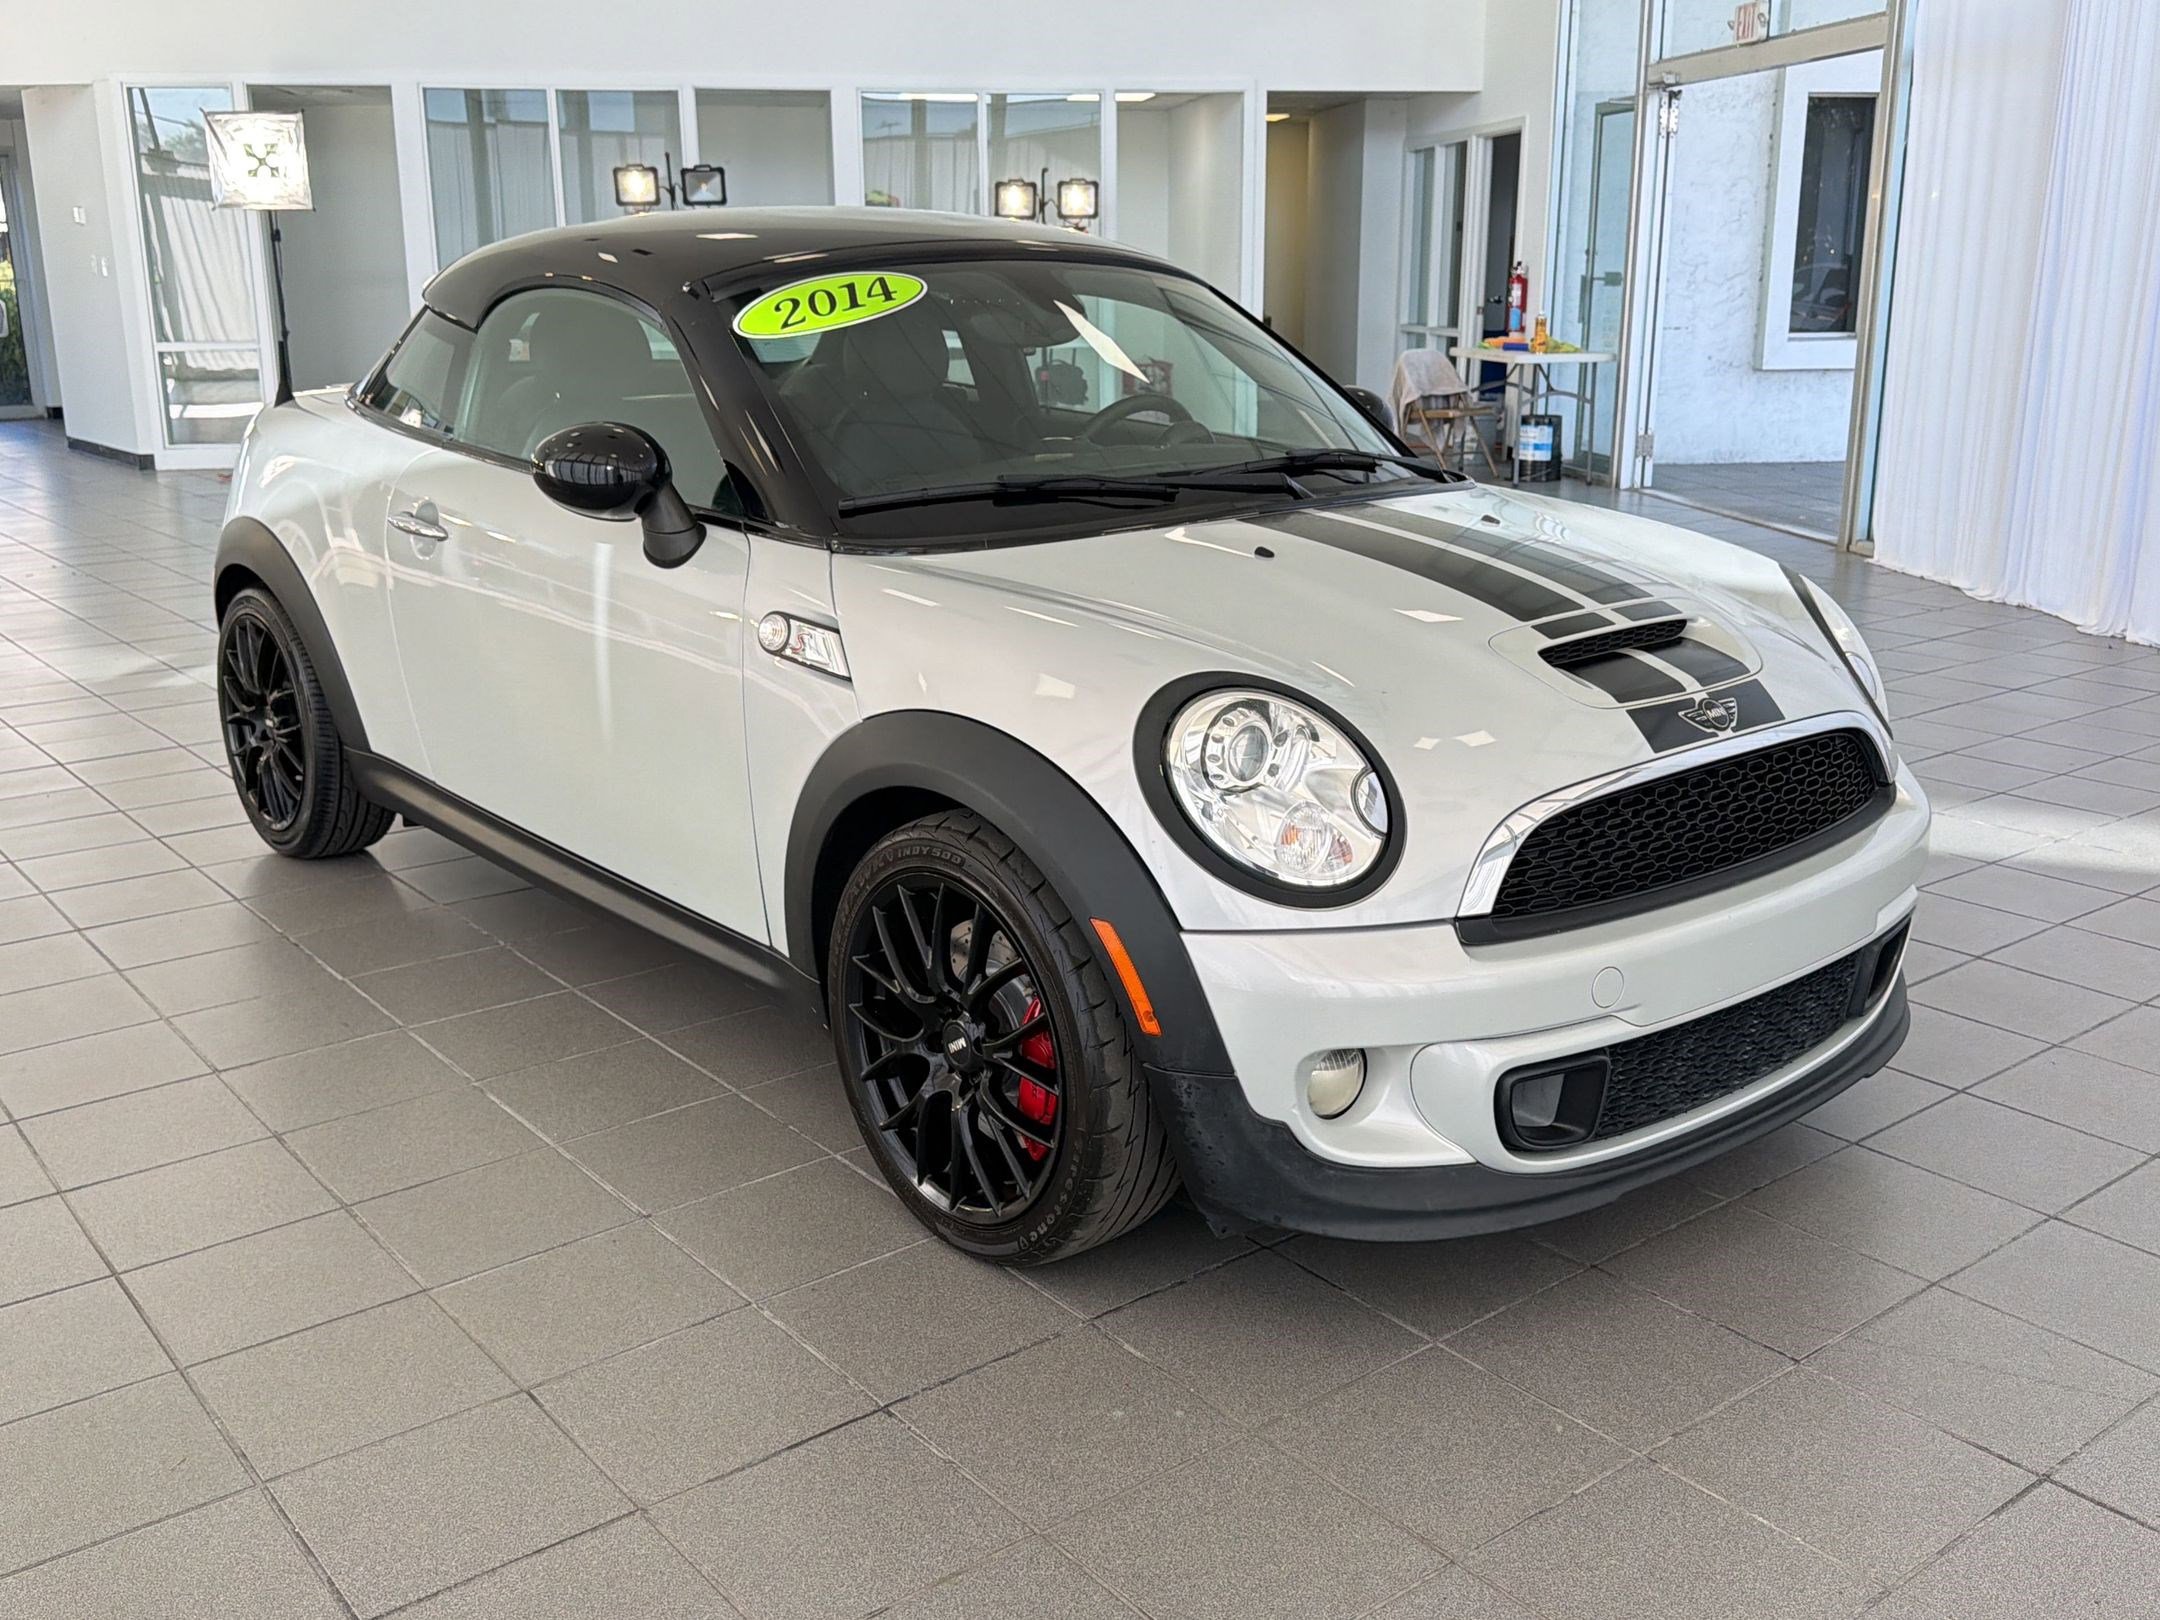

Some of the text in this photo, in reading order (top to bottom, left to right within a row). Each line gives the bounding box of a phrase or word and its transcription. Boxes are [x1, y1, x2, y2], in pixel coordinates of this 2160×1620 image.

[1736, 4, 1758, 41] EXIT
[774, 276, 898, 330] 2014
[1705, 706, 1728, 719] MINI
[947, 1036, 967, 1054] MINI
